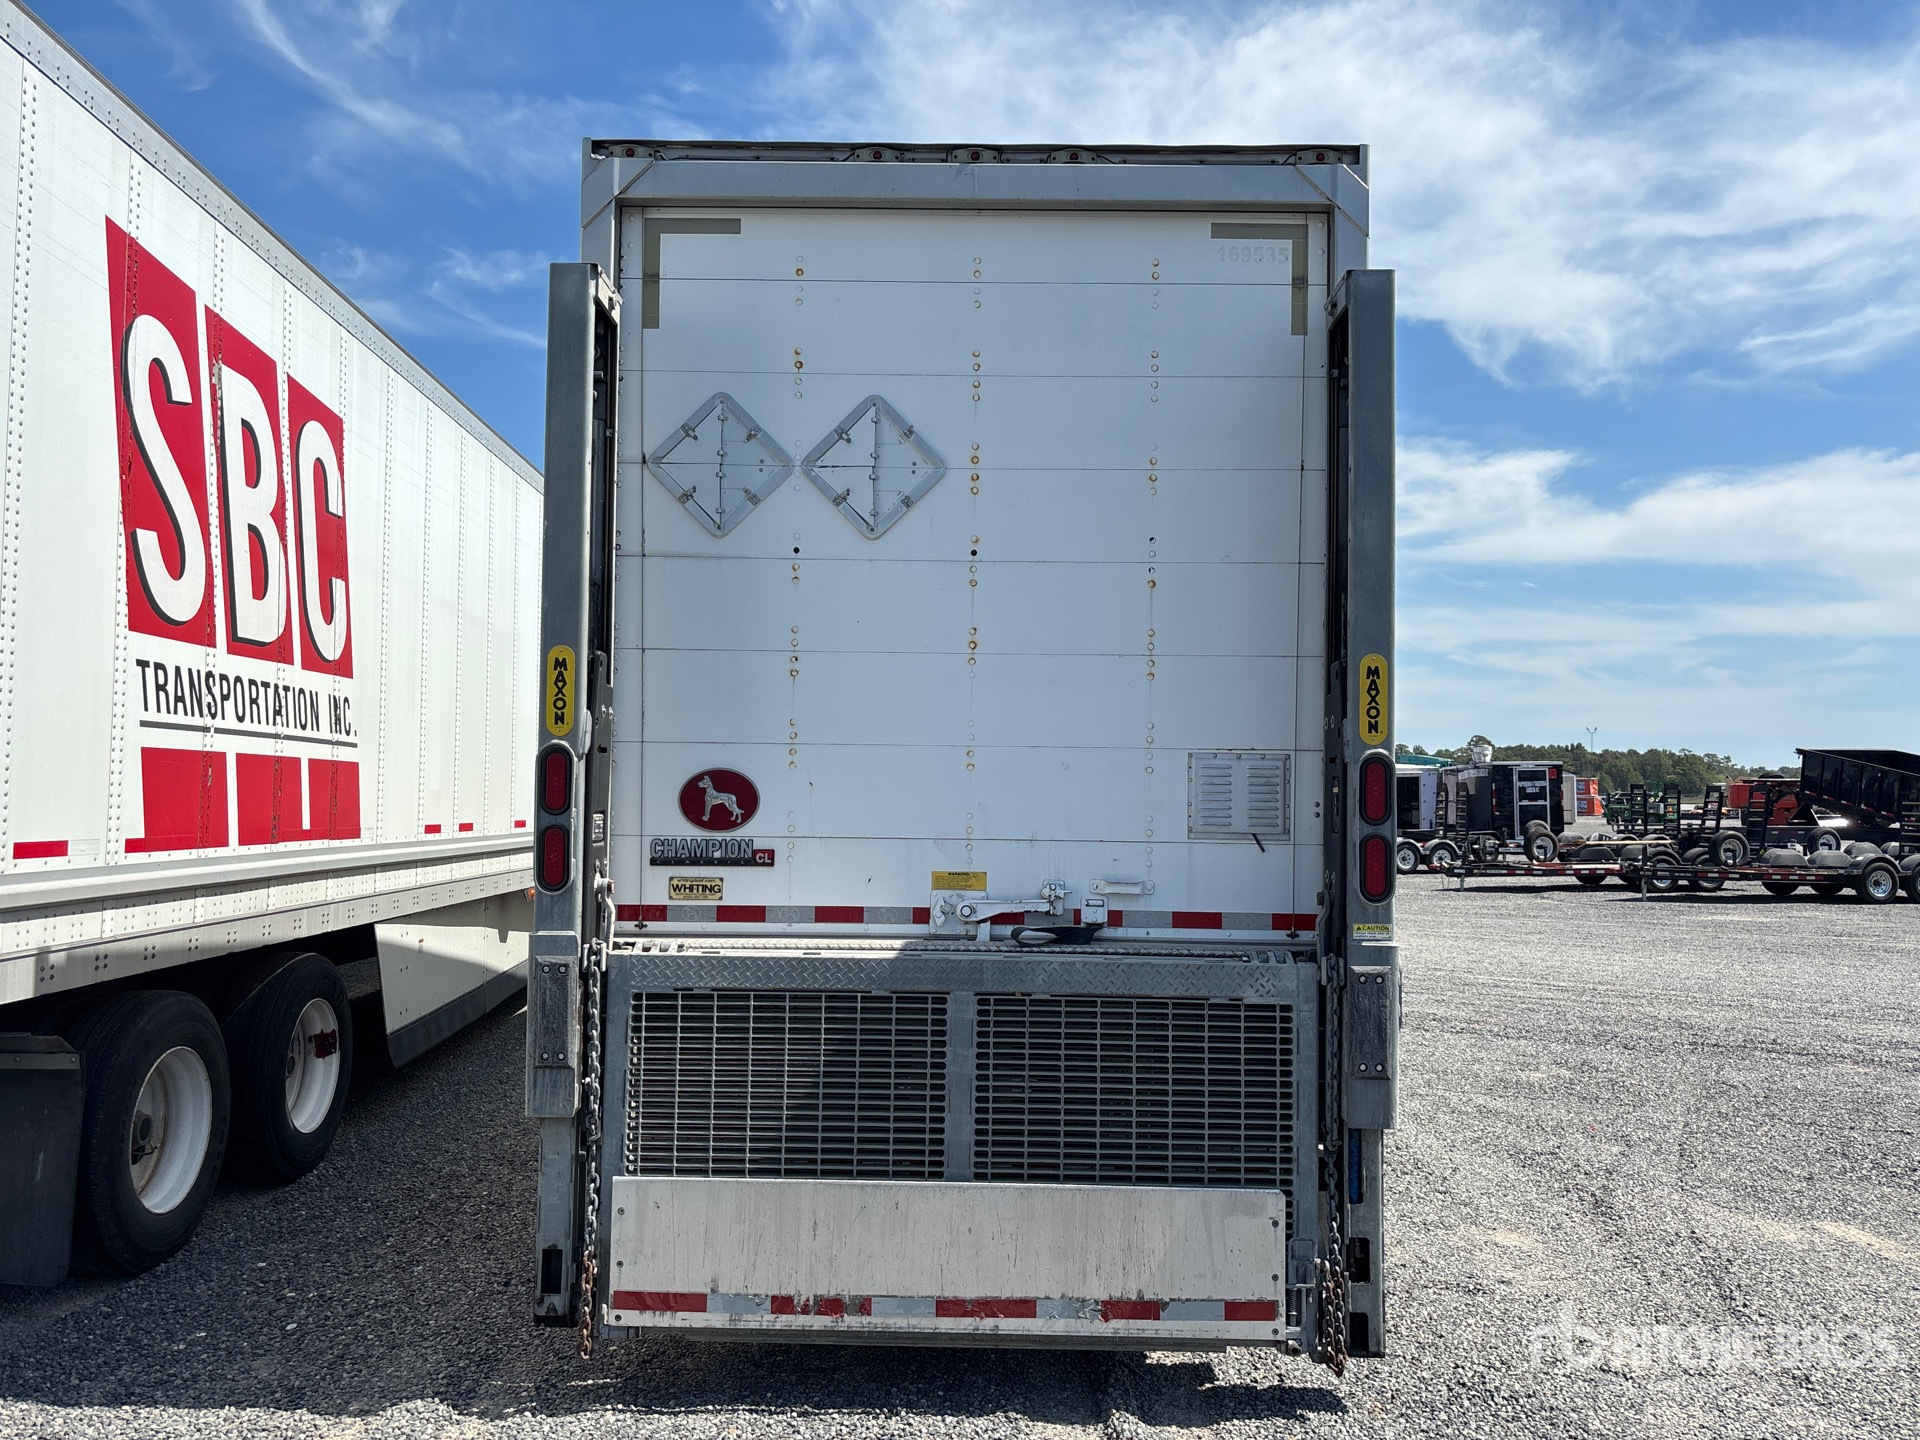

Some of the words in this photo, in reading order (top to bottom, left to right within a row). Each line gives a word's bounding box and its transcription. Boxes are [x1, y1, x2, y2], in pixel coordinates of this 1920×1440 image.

[1216, 245, 1290, 264] 169535
[122, 312, 345, 663] SBC
[135, 658, 320, 733] TRANSPORTATION
[327, 693, 358, 738] INC.
[553, 656, 568, 726] MAXON
[1366, 665, 1381, 735] MAXON
[650, 838, 754, 859] CHAMPION
[755, 853, 772, 863] CL
[671, 883, 722, 894] WHITING
